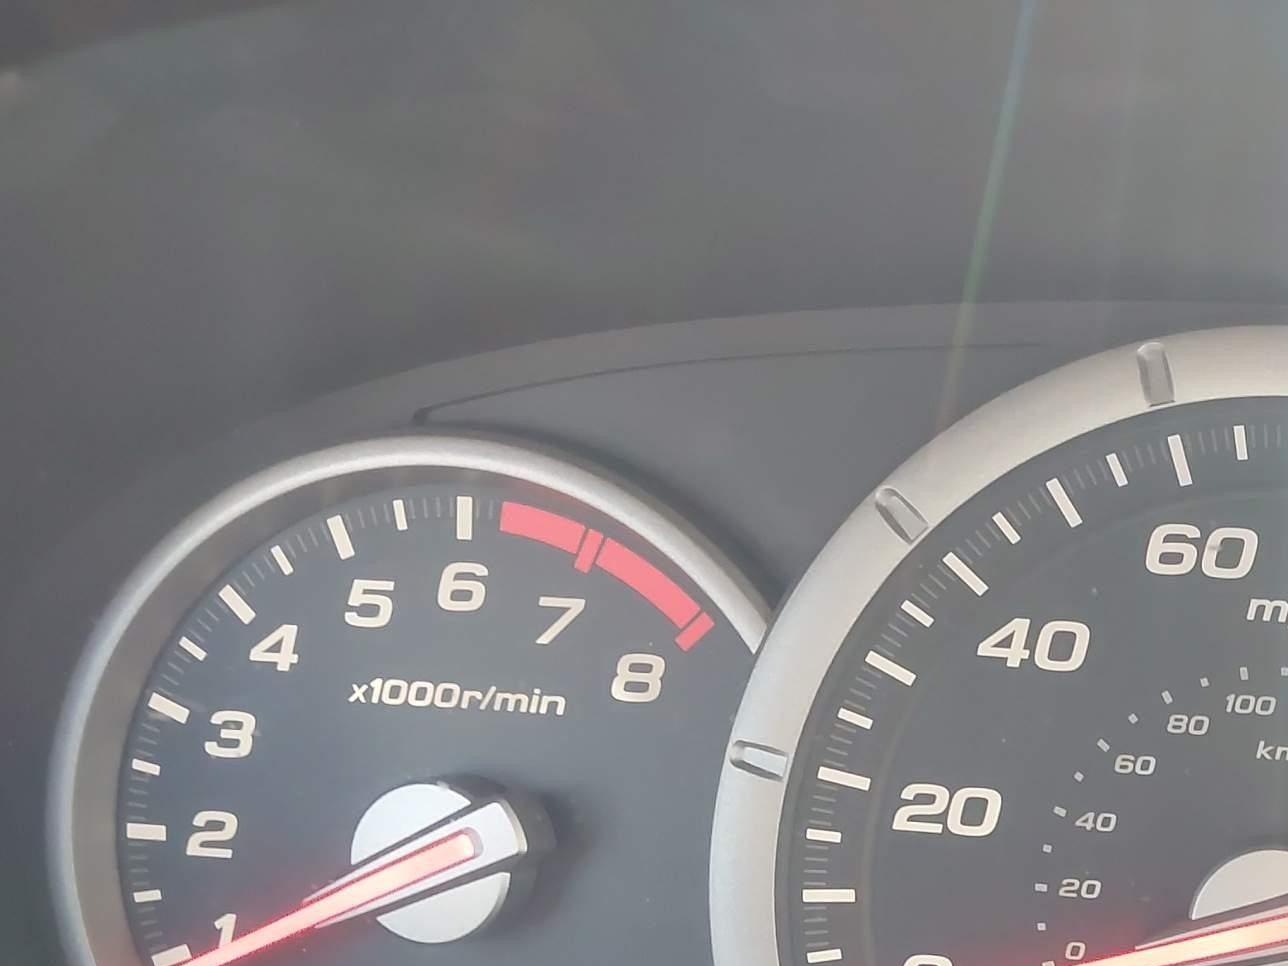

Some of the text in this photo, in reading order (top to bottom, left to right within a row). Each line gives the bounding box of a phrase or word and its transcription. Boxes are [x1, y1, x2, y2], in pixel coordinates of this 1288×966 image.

[1146, 524, 1258, 578] 60
[345, 579, 394, 627] 5
[438, 563, 488, 611] 6
[536, 597, 585, 644] 7
[249, 625, 298, 671] 4
[977, 618, 1089, 671] 40
[611, 654, 665, 702] 8
[1167, 715, 1209, 735] 80
[1227, 694, 1276, 715] 100
[205, 711, 255, 757] 3
[1115, 755, 1156, 774] 60
[893, 784, 1001, 836] 20
[1075, 812, 1116, 831] 40
[186, 811, 237, 858] 2
[1059, 879, 1101, 898] 20
[213, 913, 239, 949] 1
[1065, 942, 1085, 961] 0
